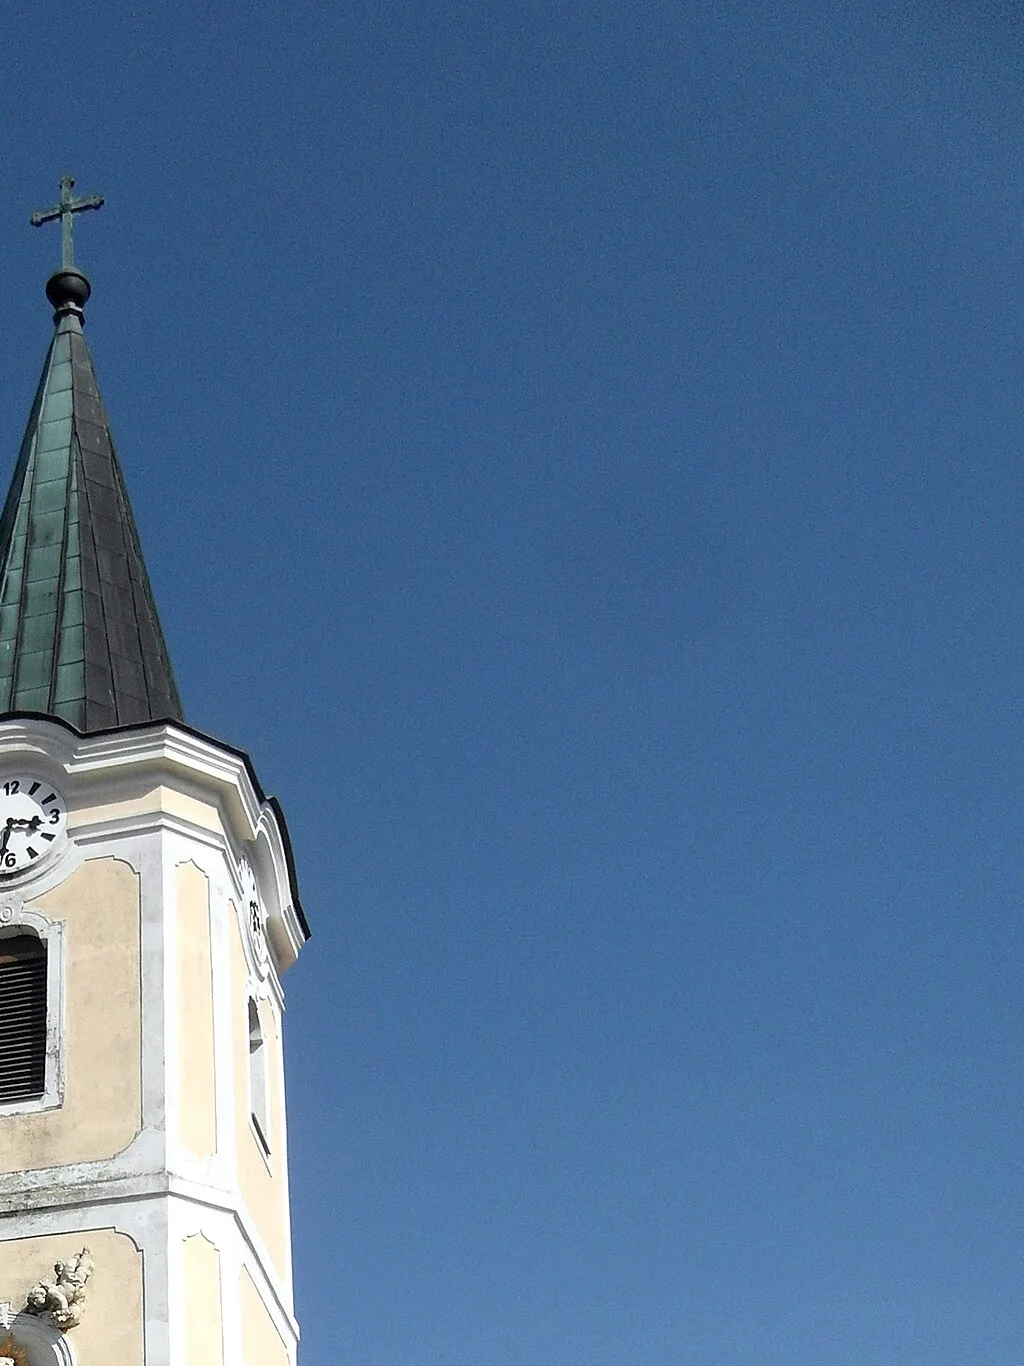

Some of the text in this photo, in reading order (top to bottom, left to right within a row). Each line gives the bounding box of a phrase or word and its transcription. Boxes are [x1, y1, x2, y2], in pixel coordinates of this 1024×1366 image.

[3, 780, 20, 796] 12
[49, 808, 60, 825] 3
[5, 853, 16, 867] 6
